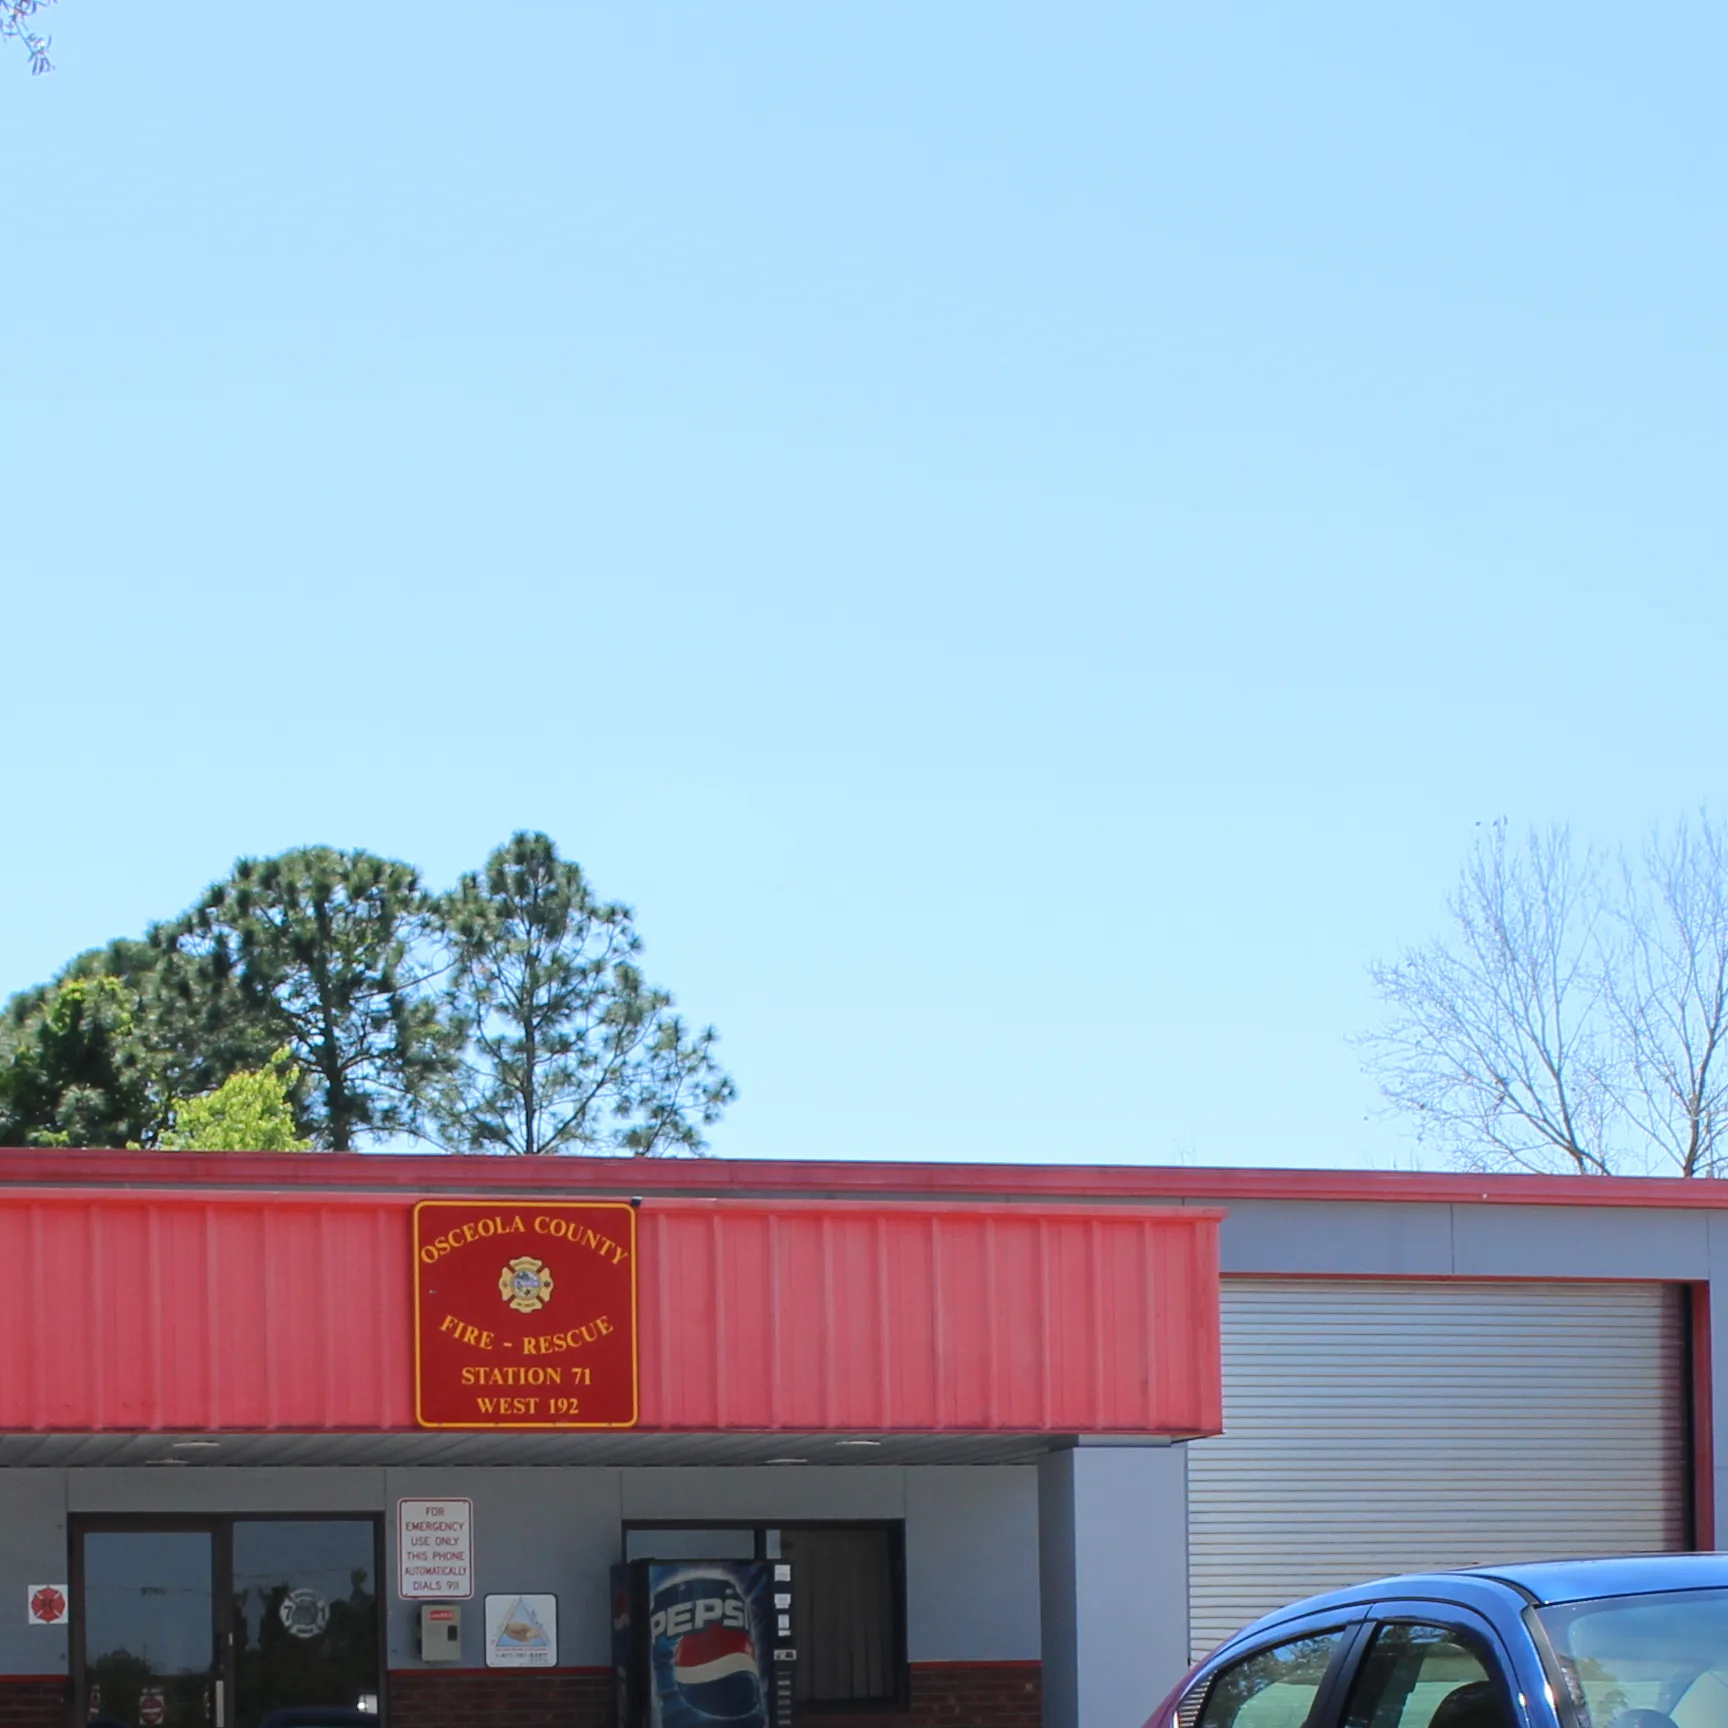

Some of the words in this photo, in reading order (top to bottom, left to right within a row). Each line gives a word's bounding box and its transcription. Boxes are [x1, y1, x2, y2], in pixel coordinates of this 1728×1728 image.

[421, 1215, 526, 1264] OSCEOLA
[534, 1215, 629, 1266] COUNTY
[439, 1314, 495, 1350] FIRE
[523, 1315, 614, 1355] RESCUE
[461, 1366, 562, 1385] STATION
[572, 1367, 591, 1385] 71
[476, 1397, 539, 1414] WEST
[549, 1397, 579, 1414] 192
[425, 1506, 445, 1517] FOR
[405, 1521, 465, 1532] EMERGENCY
[411, 1536, 430, 1546] USE
[435, 1536, 459, 1546] ONLY
[407, 1551, 428, 1561] THIS
[433, 1551, 465, 1561] PHONE
[404, 1566, 467, 1576] AUTOMATICALLY
[413, 1580, 441, 1590] DIALS
[446, 1580, 459, 1590] 911
[284, 1605, 293, 1621] 7
